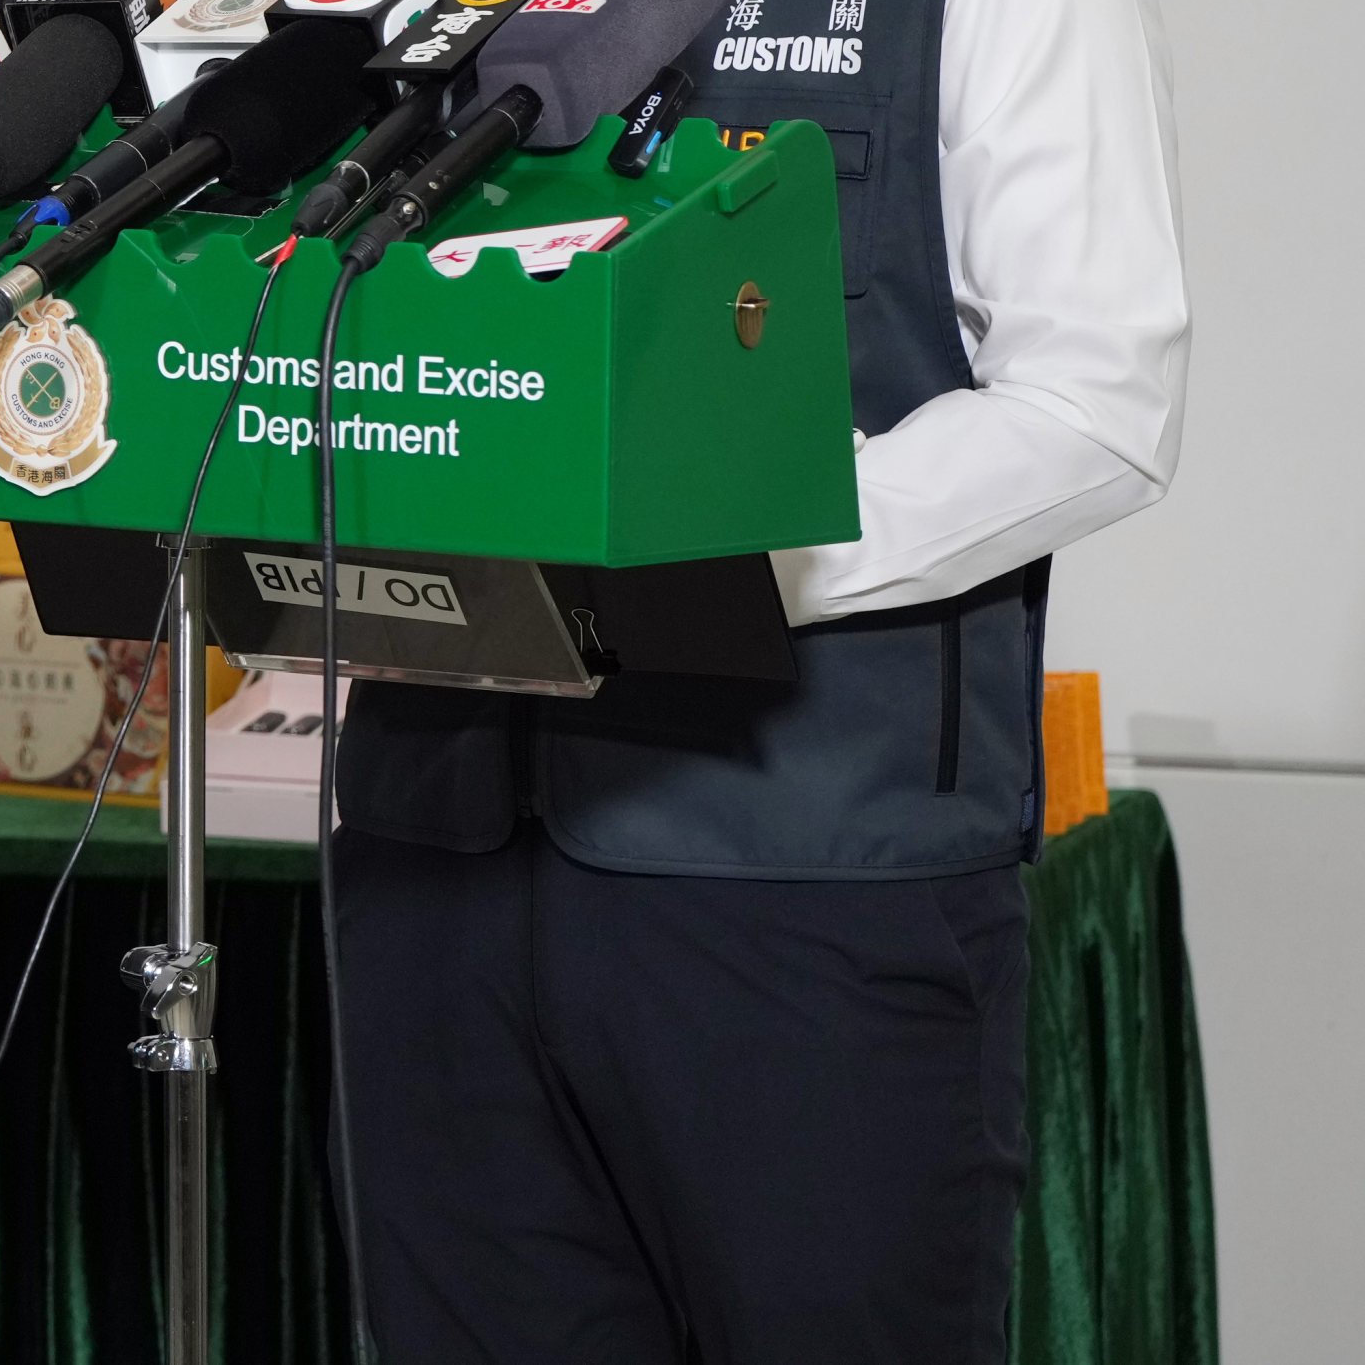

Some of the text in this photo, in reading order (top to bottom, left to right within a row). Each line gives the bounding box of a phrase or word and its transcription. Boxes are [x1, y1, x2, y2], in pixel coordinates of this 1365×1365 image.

[712, 35, 864, 75] CUSTOMS
[628, 94, 662, 136] BOYA
[19, 351, 66, 370] HONG KONG
[157, 341, 545, 401] Customs and Excise
[11, 392, 74, 429] CUSTOMS AND EXCISE
[15, 463, 67, 485] 香港海關
